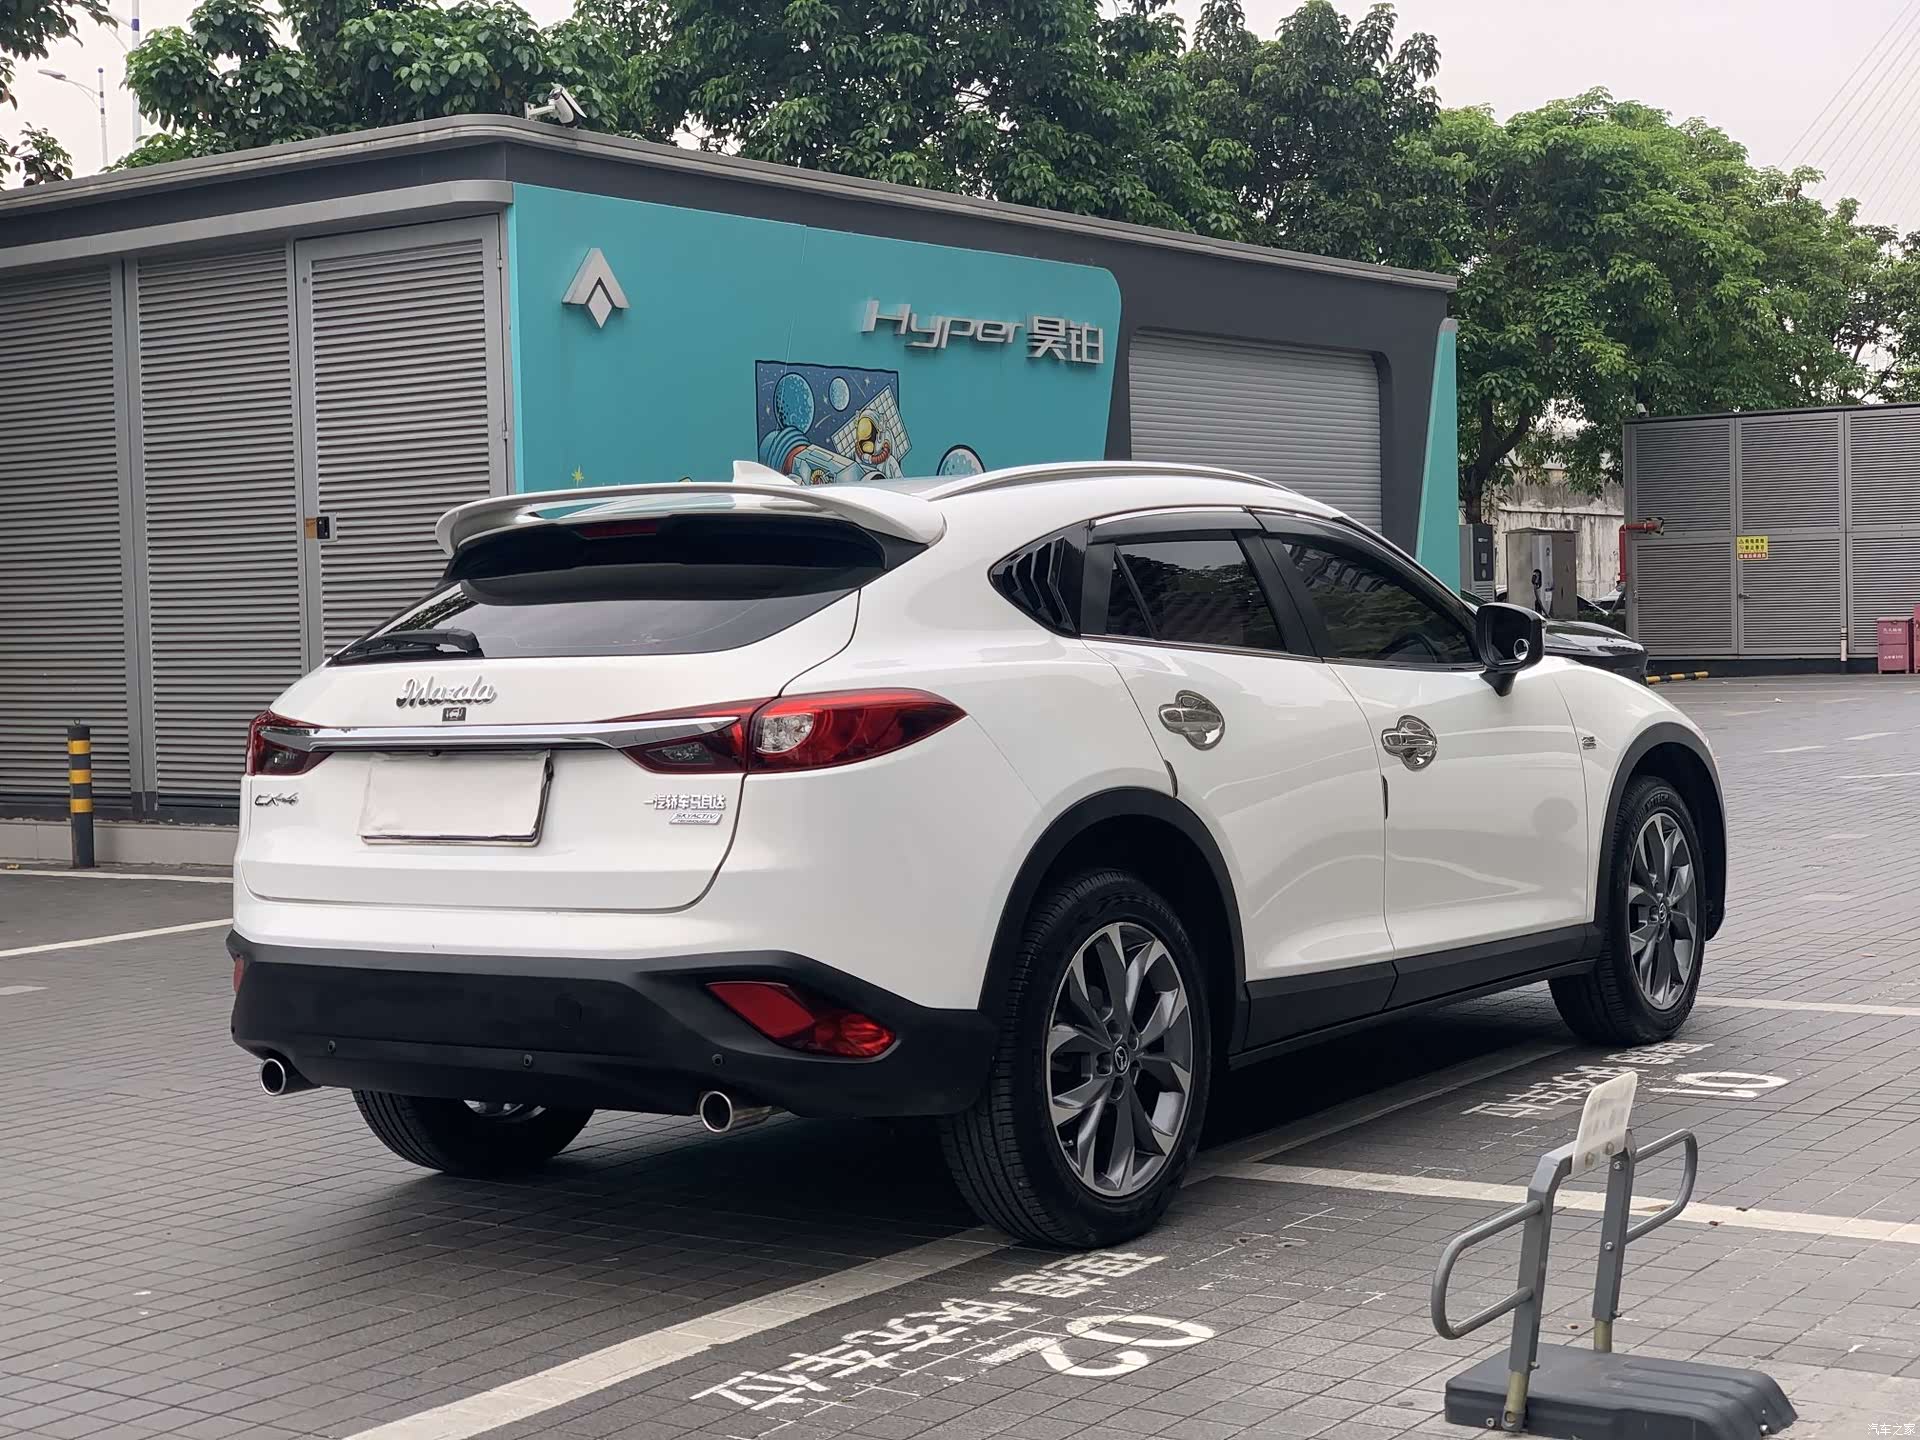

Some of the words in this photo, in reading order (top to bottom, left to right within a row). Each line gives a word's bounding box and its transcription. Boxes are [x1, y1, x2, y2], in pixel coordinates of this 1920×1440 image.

[860, 300, 1023, 348] Hyper
[1027, 315, 1104, 363] 昊铂
[255, 792, 299, 807] CX-4
[643, 794, 727, 810] 一汽轿车马自达
[988, 1251, 1168, 1299] 理想
[690, 1298, 1042, 1411] 快充车位
